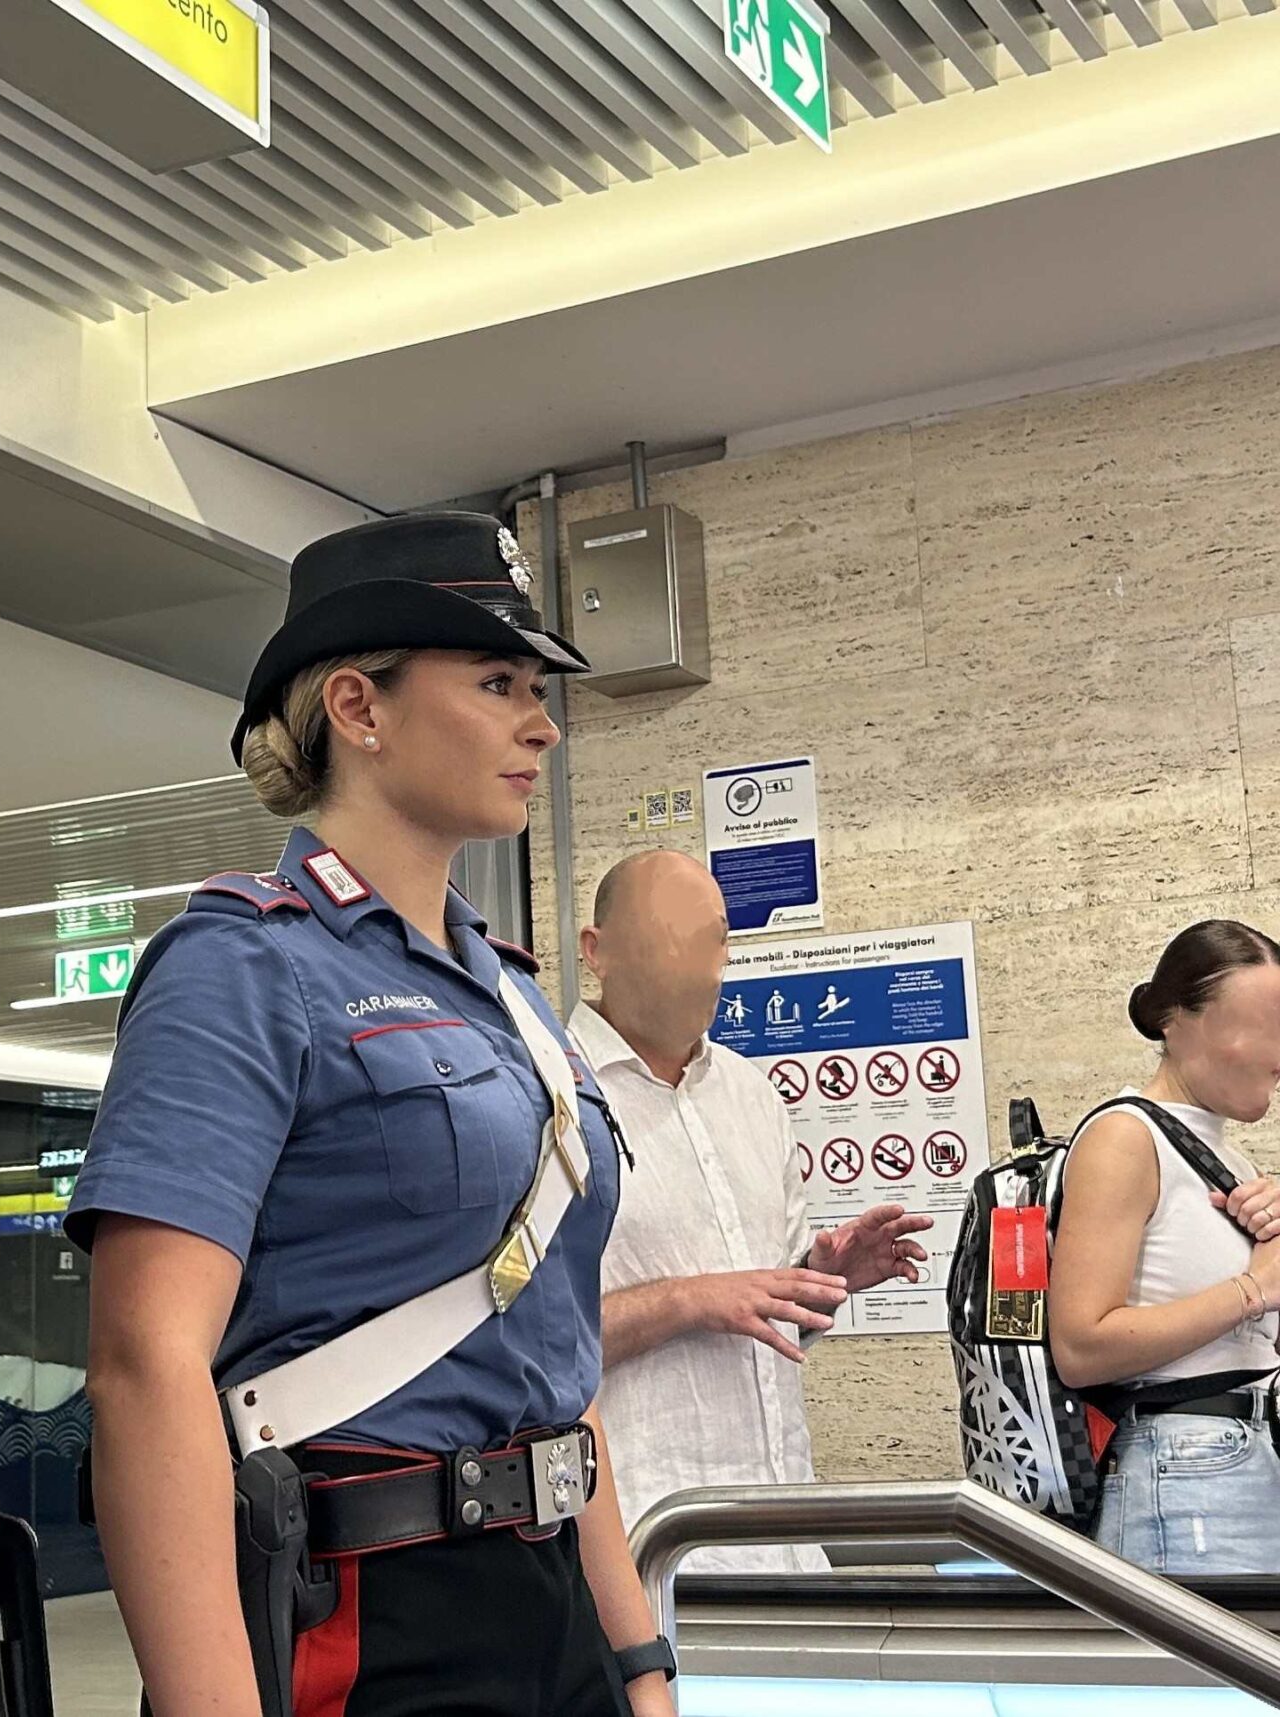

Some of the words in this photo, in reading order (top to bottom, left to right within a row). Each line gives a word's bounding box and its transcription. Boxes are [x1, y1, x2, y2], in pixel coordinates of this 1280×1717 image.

[724, 823, 751, 832] Avviso
[753, 820, 761, 829] al
[763, 817, 798, 829] pubblico
[753, 952, 783, 963] mobili
[793, 944, 851, 959] Disposizioni
[854, 944, 870, 955] per
[879, 936, 936, 951] viaggiatori
